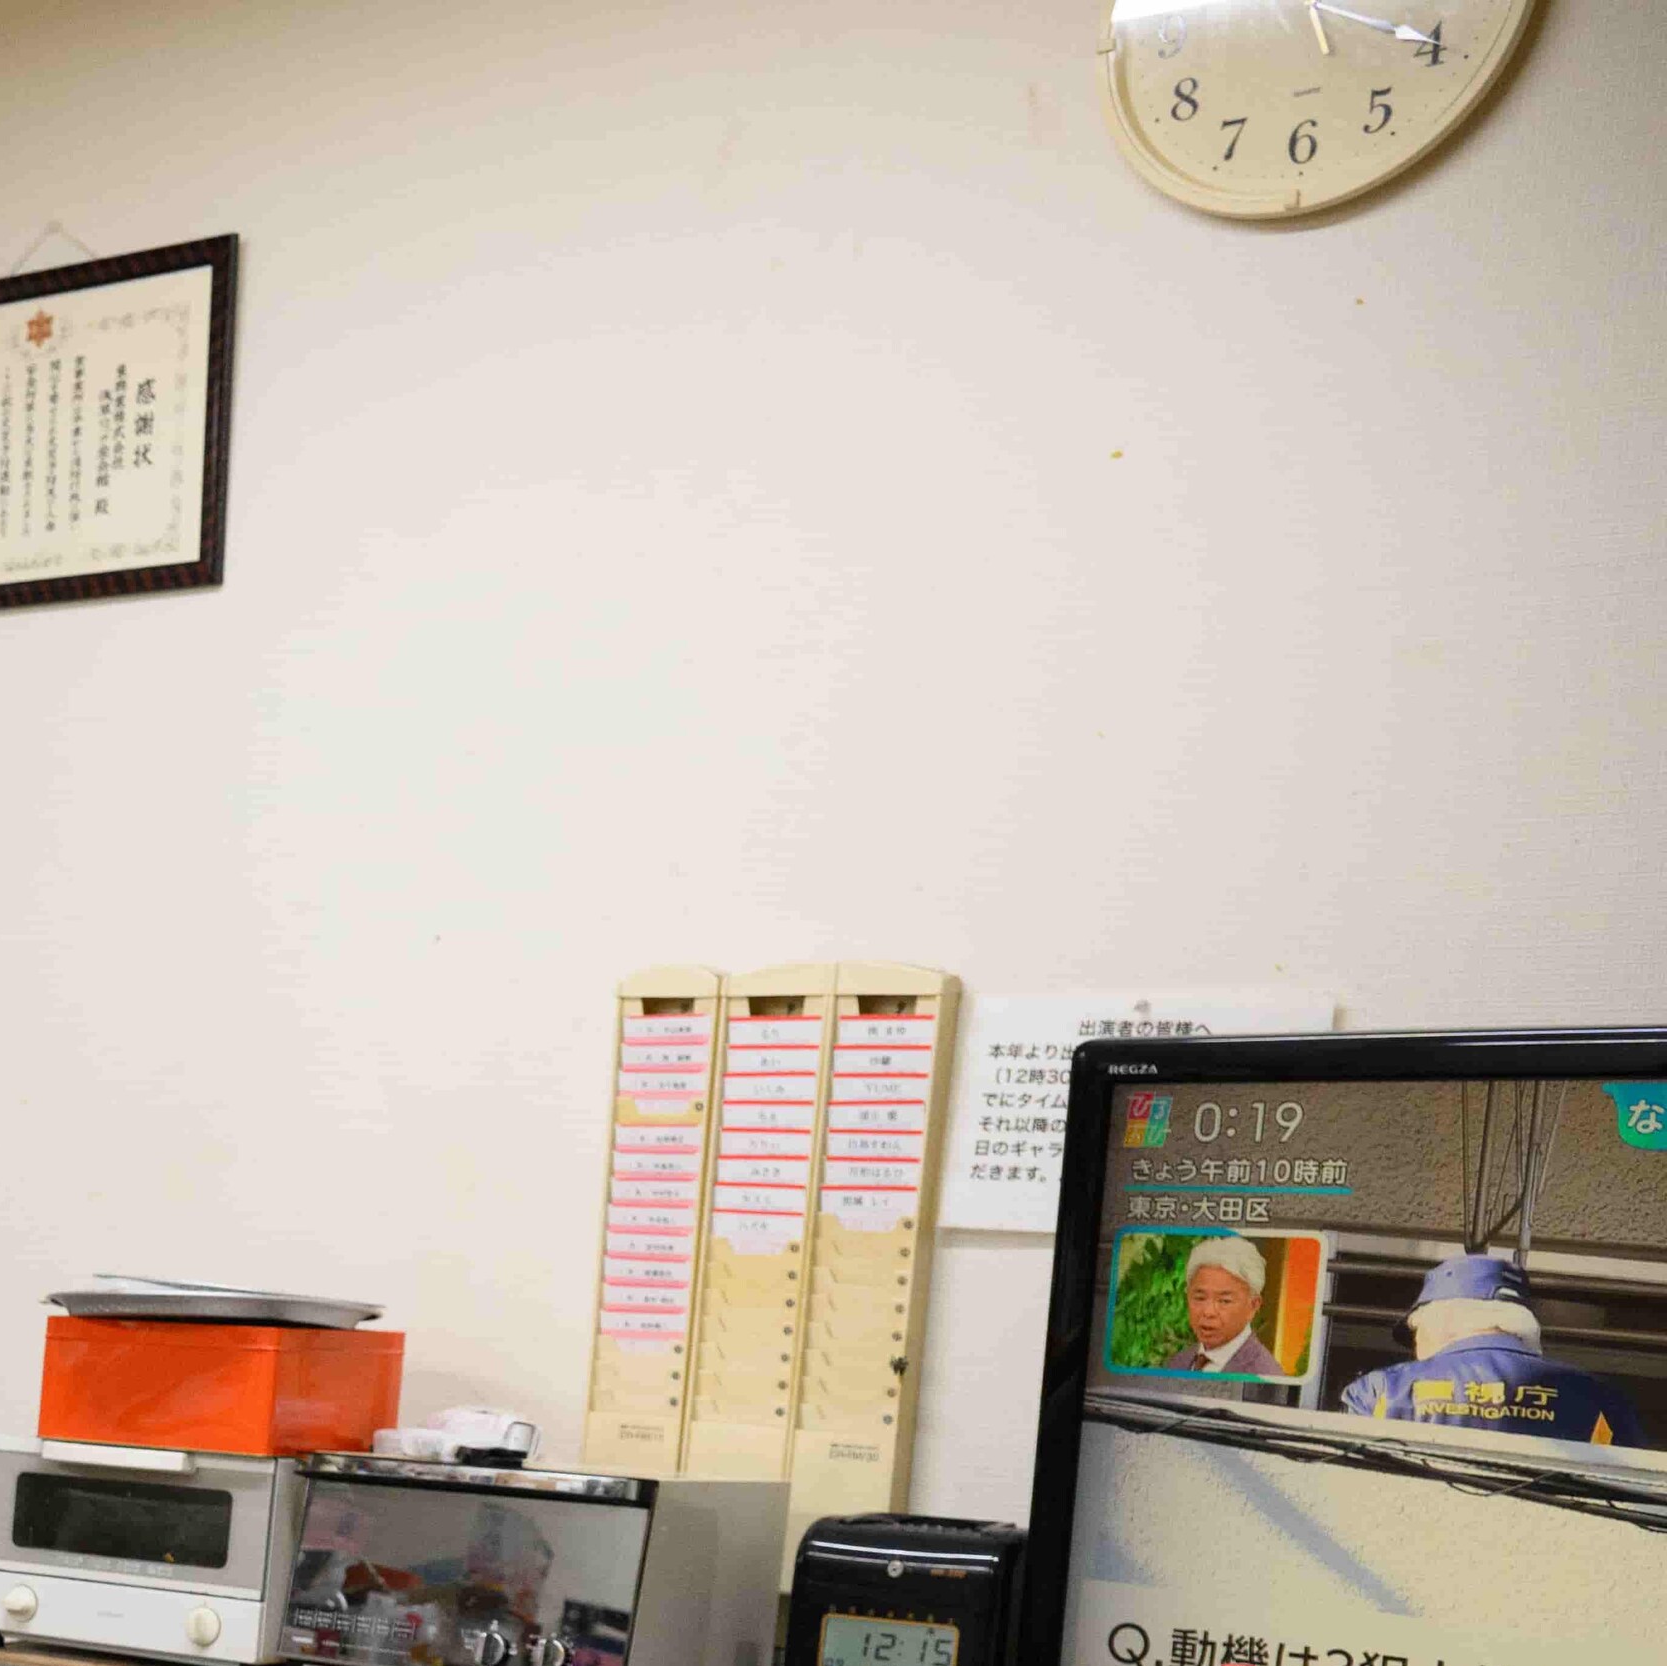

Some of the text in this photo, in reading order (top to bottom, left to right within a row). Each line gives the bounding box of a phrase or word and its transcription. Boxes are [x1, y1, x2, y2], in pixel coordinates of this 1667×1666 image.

[1412, 19, 1449, 68] 4
[1170, 76, 1201, 122] 8
[1363, 86, 1395, 134] 5
[1219, 116, 1249, 162] 7
[1287, 118, 1319, 165] 6
[133, 377, 156, 468] 感謝状
[1078, 1019, 1214, 1037] 出演者の皆様へ
[1108, 1064, 1159, 1076] REGZA
[1193, 1101, 1305, 1144] 0:19
[969, 1165, 1048, 1182] だきます。
[1131, 1158, 1349, 1184] きょう午前10時前
[1127, 1195, 1272, 1223] 東京・大田区
[1412, 1379, 1560, 1403] 視庁
